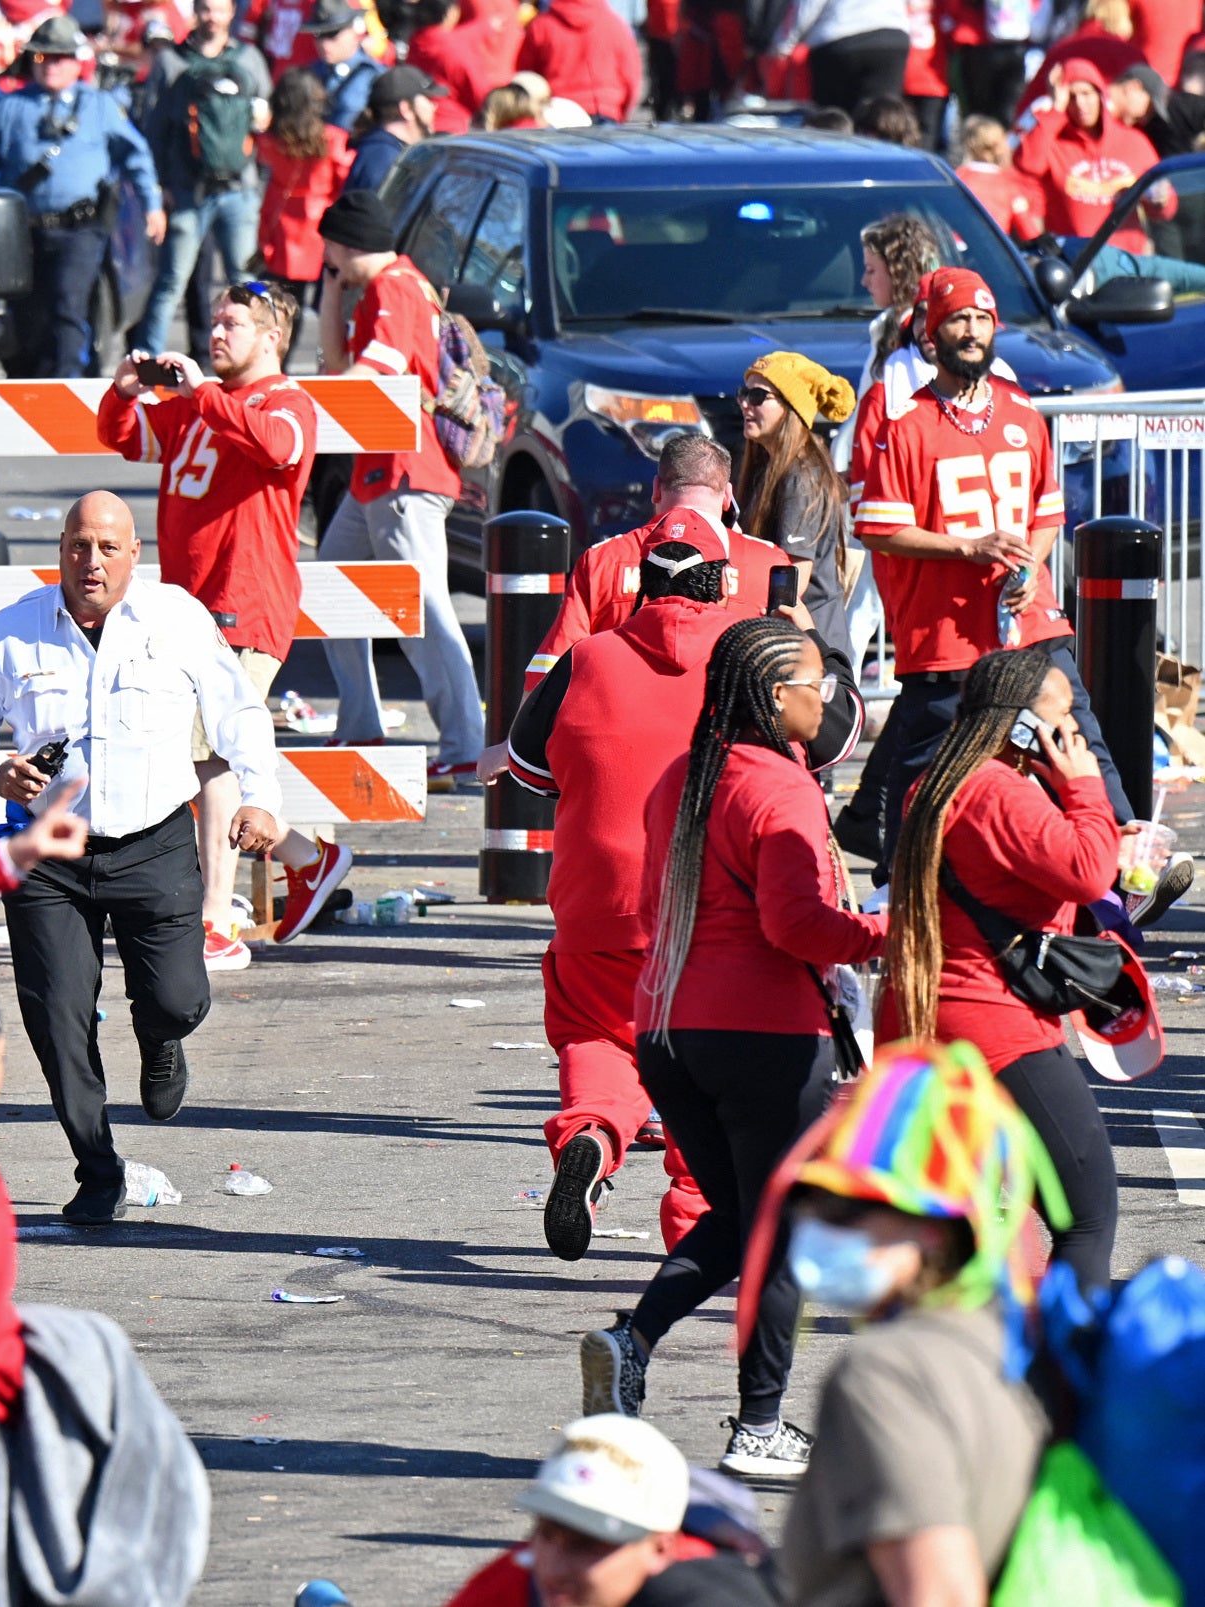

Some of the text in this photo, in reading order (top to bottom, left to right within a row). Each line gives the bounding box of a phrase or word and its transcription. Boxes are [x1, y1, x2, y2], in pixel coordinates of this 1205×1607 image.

[167, 416, 218, 499] 15
[1145, 418, 1205, 433] NATION
[937, 450, 1032, 541] 58
